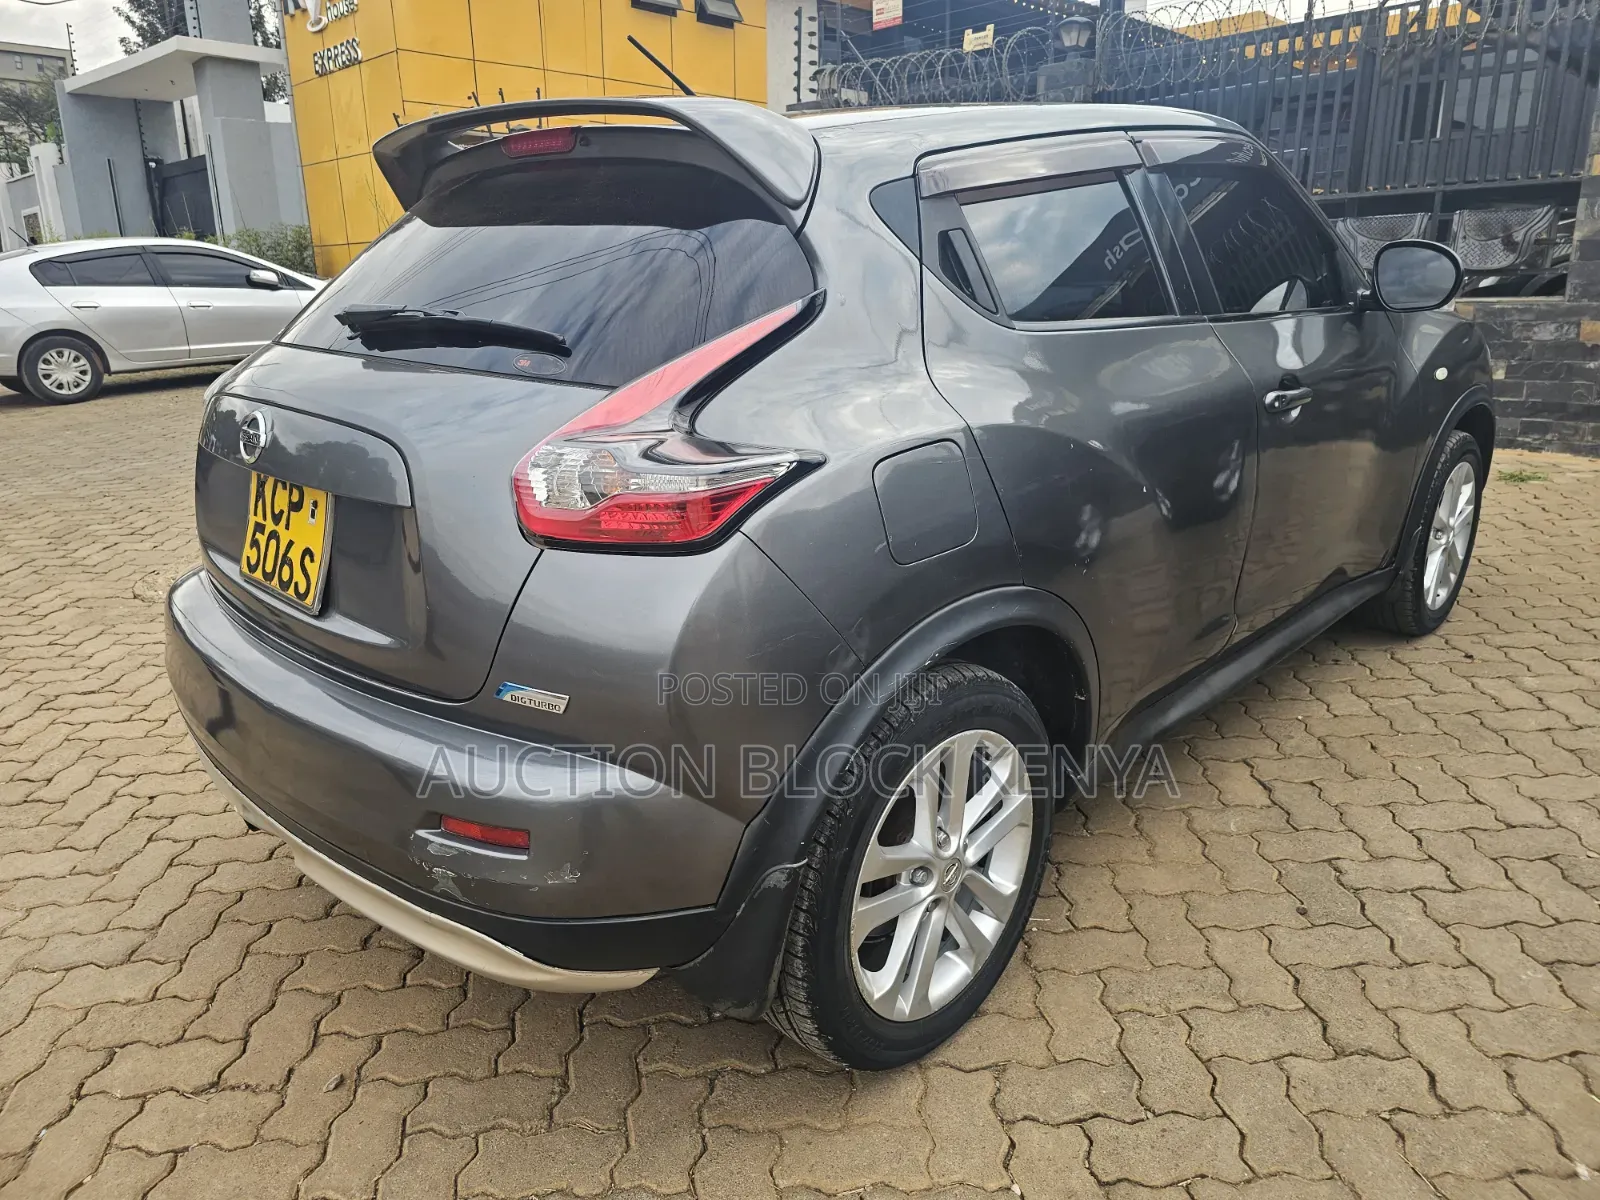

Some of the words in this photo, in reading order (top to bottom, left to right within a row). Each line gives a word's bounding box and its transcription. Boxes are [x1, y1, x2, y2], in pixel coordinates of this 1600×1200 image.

[313, 37, 361, 75] EXPRESS
[253, 472, 304, 531] KCP
[246, 521, 315, 602] 506S
